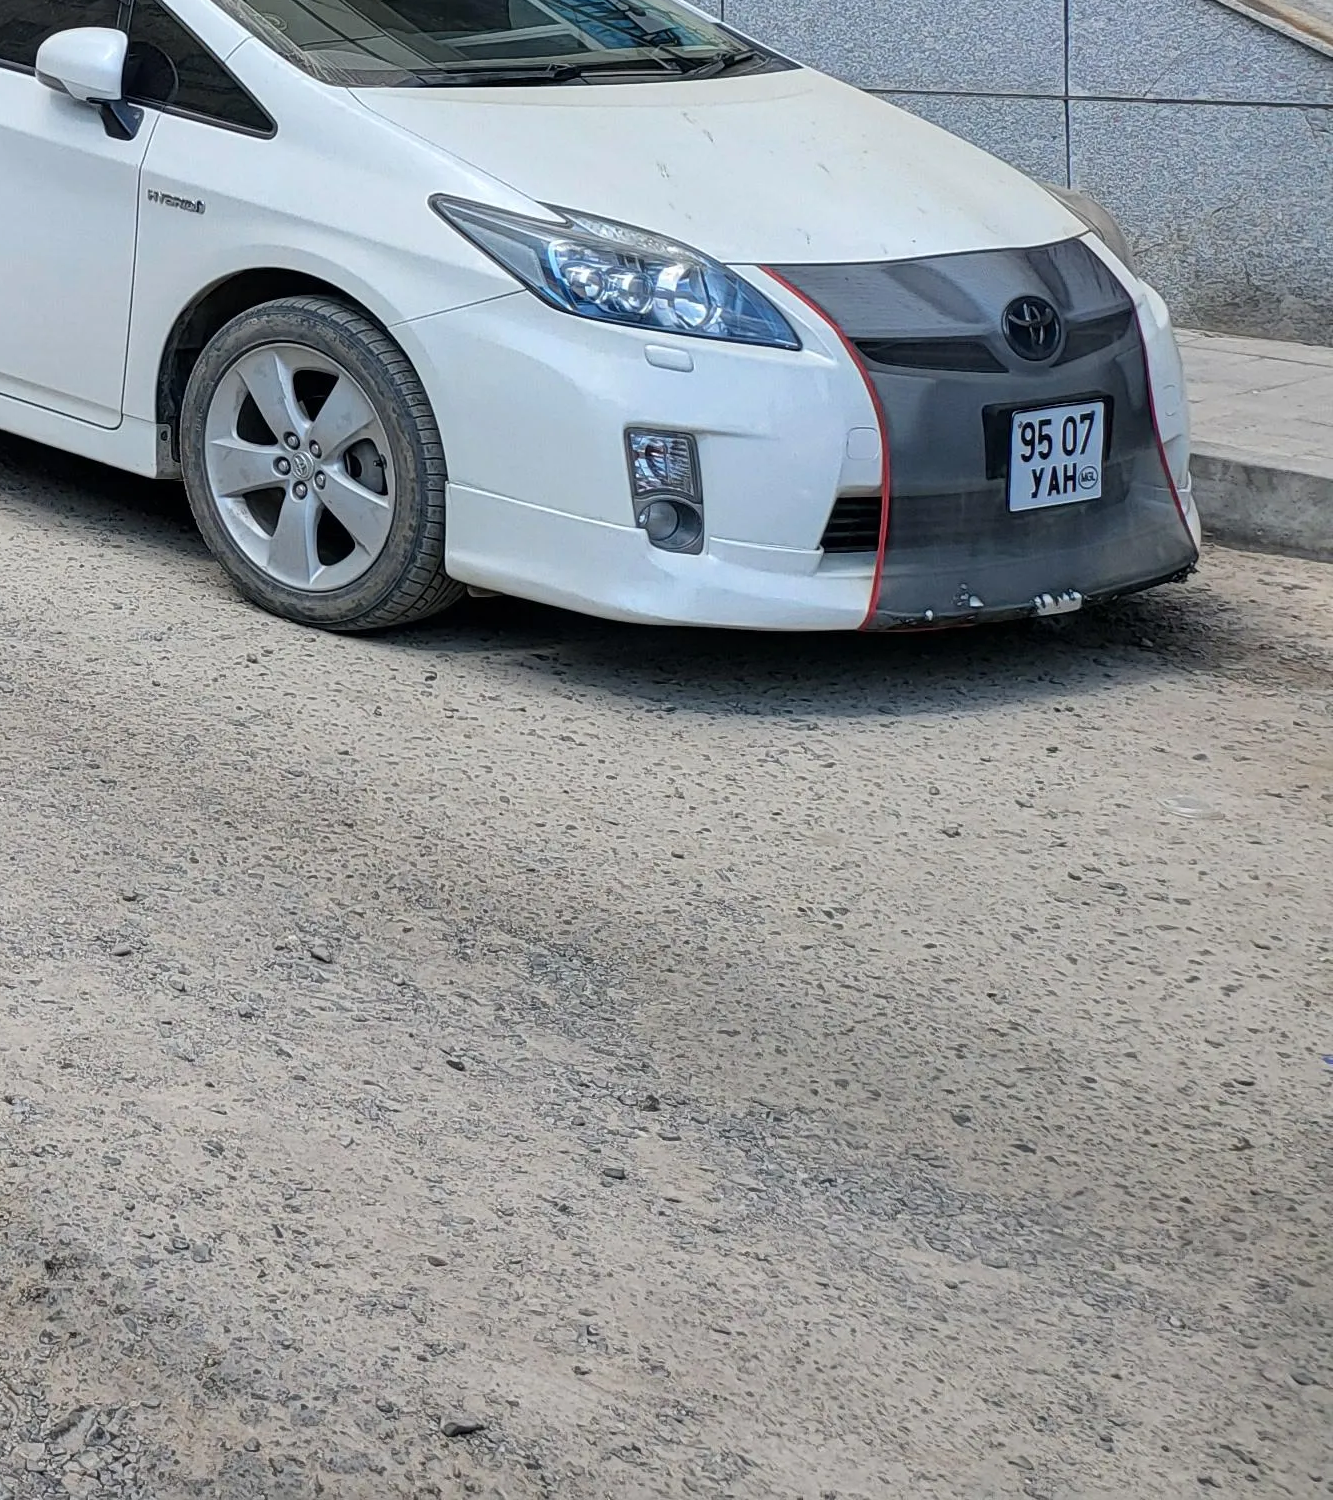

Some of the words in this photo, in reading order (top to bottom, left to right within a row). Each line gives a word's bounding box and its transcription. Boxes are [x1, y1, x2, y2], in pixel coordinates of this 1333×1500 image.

[1019, 418, 1053, 463] 95
[1062, 411, 1096, 457] 07
[1030, 462, 1078, 499] УАН
